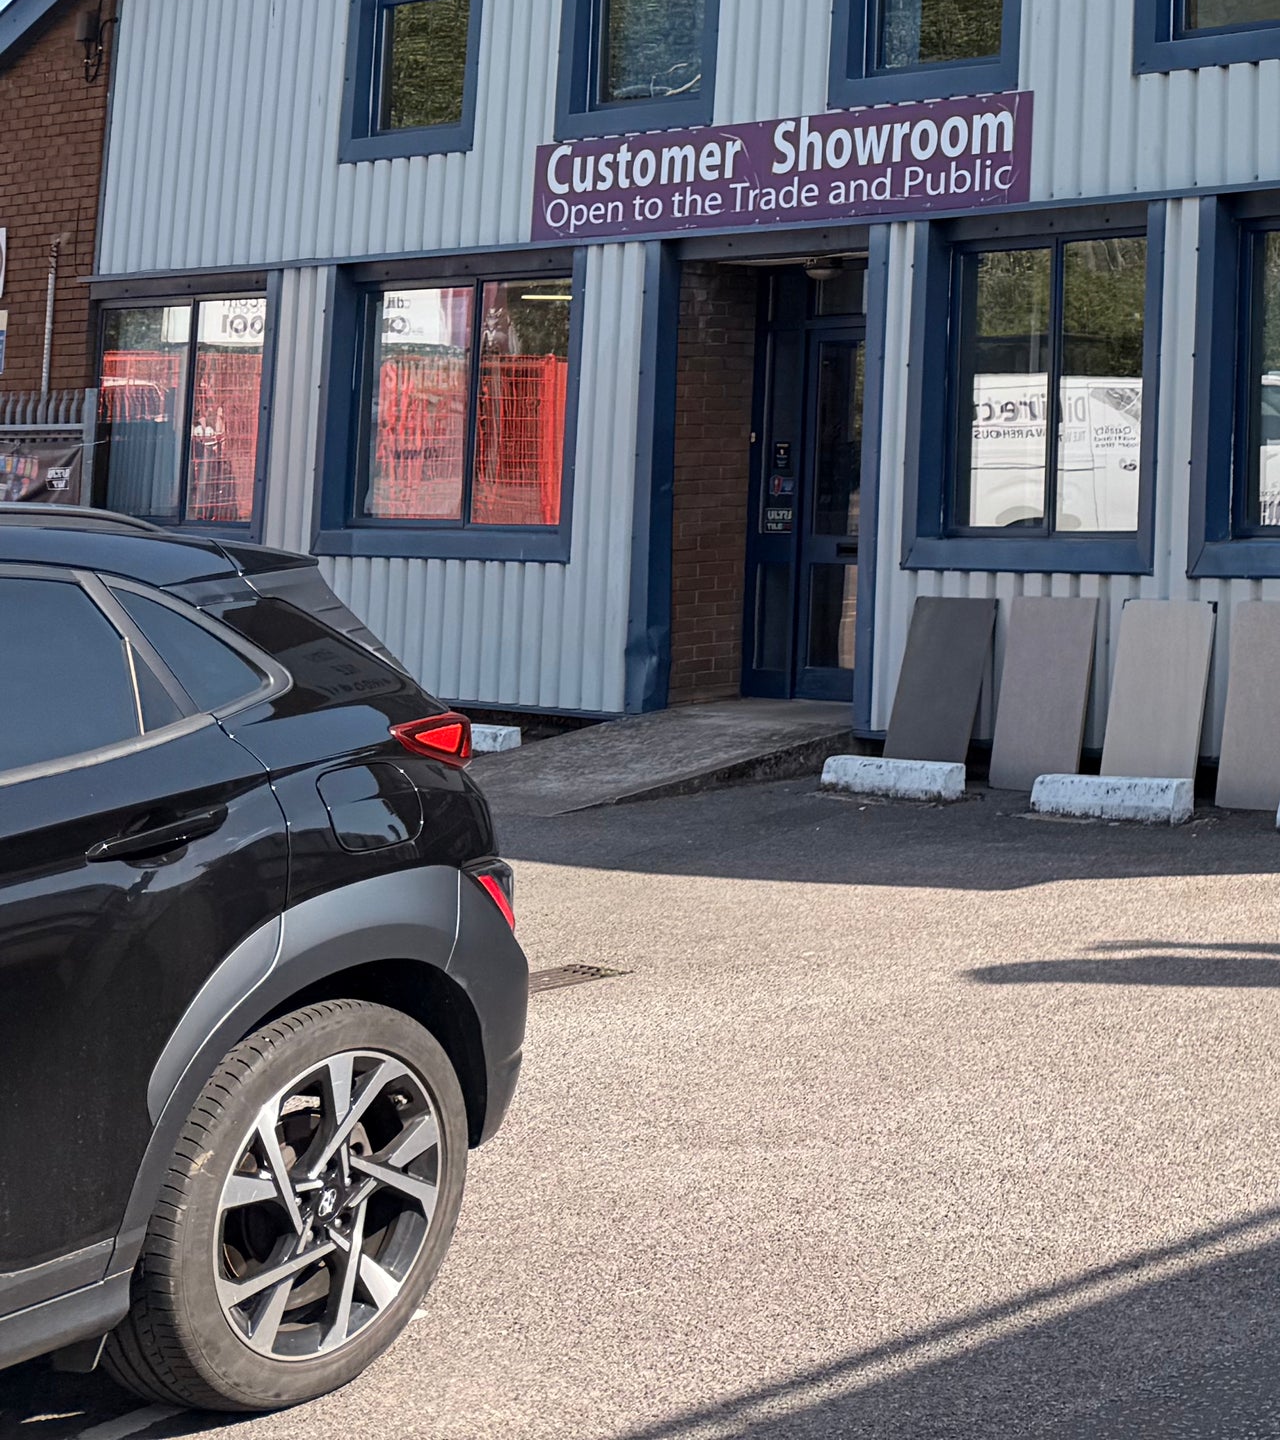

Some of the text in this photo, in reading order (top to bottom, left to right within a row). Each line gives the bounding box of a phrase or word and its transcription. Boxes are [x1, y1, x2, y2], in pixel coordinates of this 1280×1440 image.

[547, 110, 1013, 195] Customer Showroom
[545, 159, 1013, 233] Open to the Trade and Public
